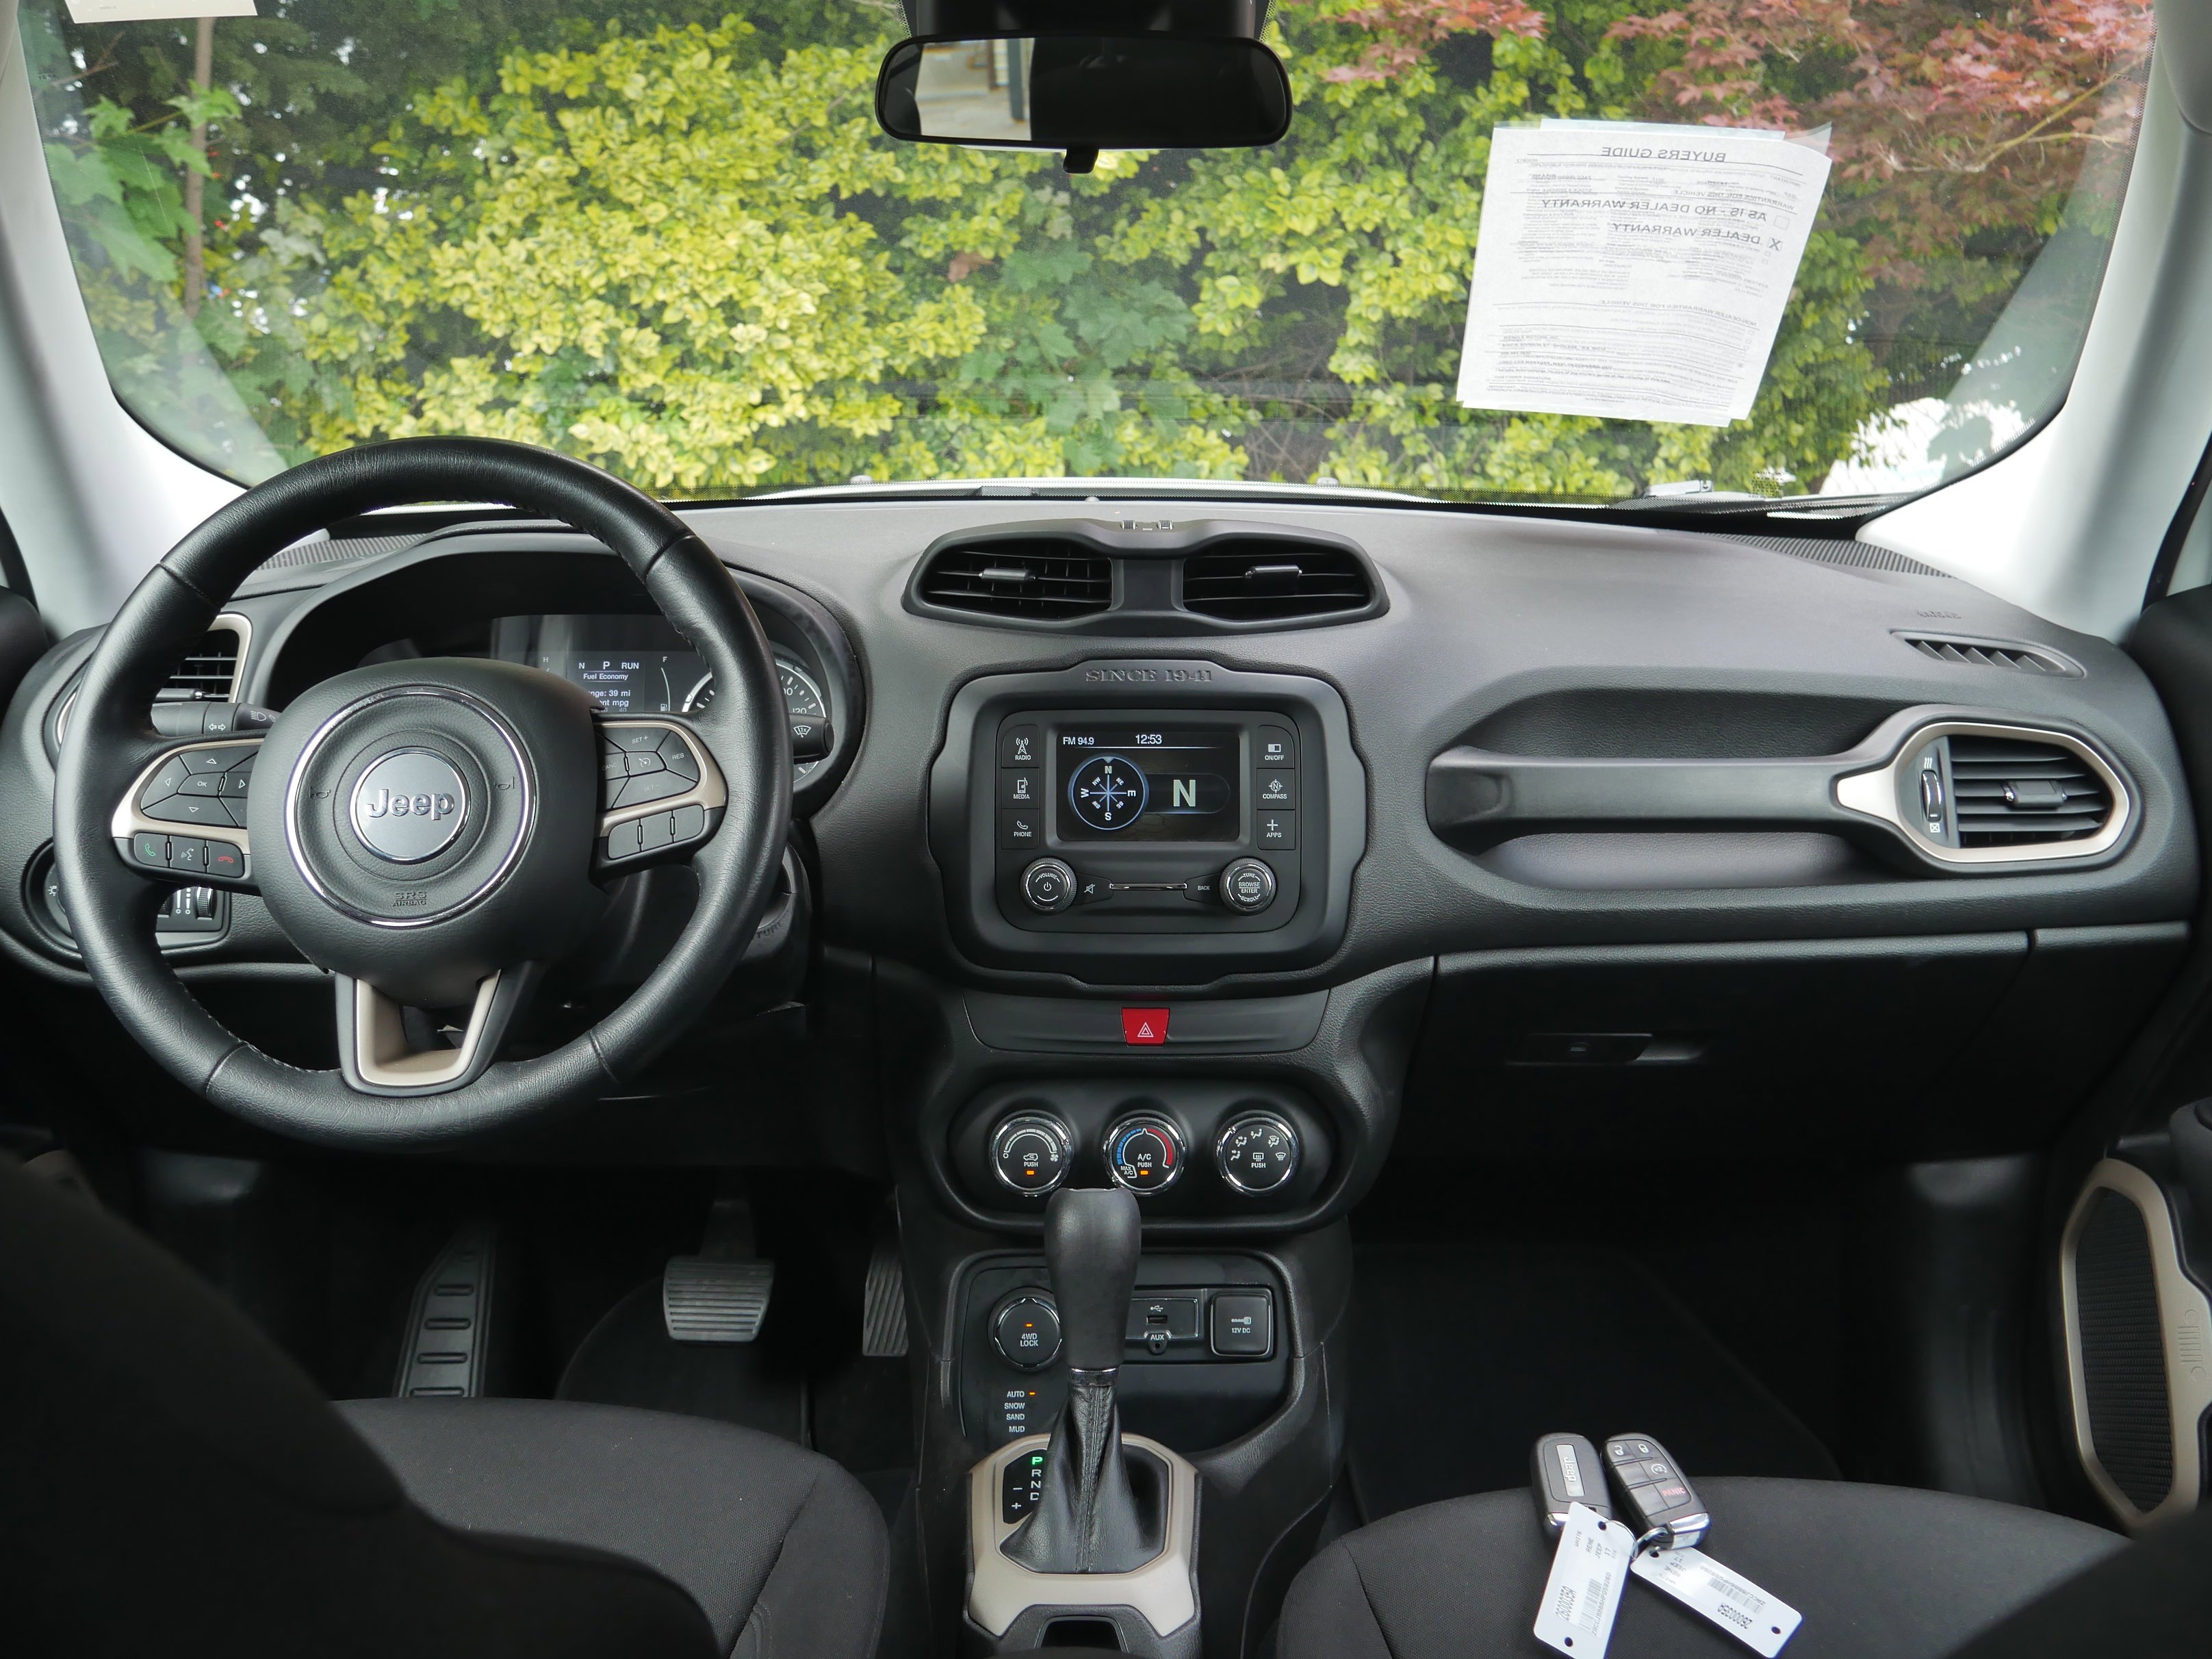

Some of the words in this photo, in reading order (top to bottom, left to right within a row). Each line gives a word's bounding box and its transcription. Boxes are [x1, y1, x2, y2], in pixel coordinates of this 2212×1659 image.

[603, 661, 610, 670] P
[1085, 669, 1157, 682] SINCE
[1077, 737, 1094, 745] 94.9
[1135, 734, 1162, 745] 12:53
[1105, 766, 1112, 774] N
[1173, 780, 1196, 807] N
[365, 788, 454, 821] Jeep
[1105, 812, 1112, 821] S
[394, 891, 427, 900] SRS
[1032, 1456, 1043, 1465] P
[1031, 1469, 1042, 1477] R
[1562, 1457, 1577, 1482] Jeep
[1031, 1480, 1041, 1489] N
[1662, 1487, 1686, 1497] PANIC
[1585, 1537, 1594, 1553] RENE
[1595, 1543, 1603, 1558] JEEP
[1604, 1547, 1611, 1556] 17
